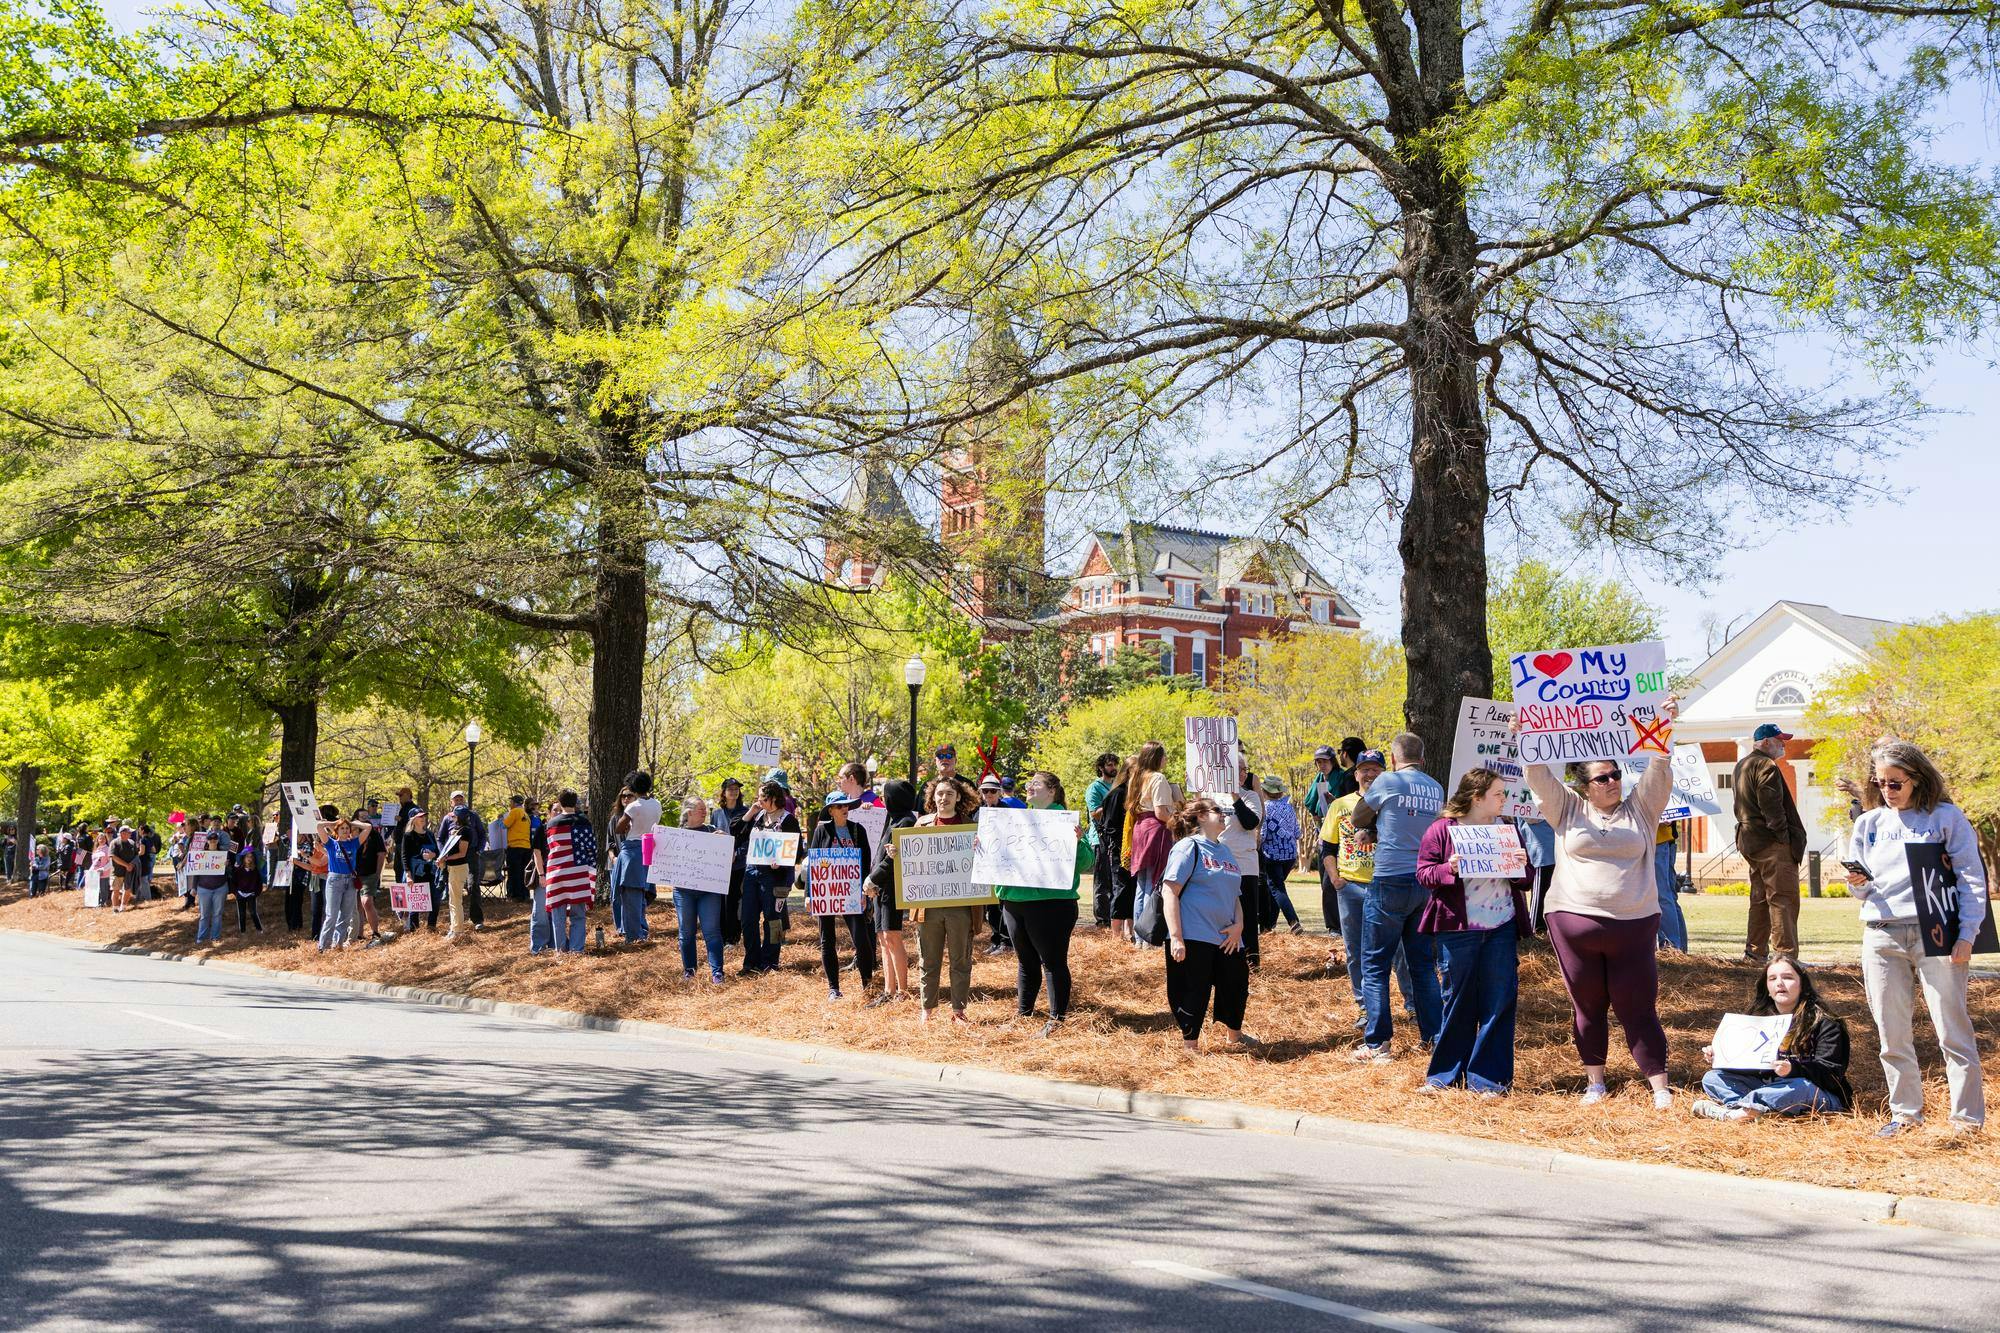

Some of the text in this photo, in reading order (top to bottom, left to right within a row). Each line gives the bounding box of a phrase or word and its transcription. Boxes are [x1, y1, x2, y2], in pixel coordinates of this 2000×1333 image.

[1512, 651, 1627, 688] I My
[1538, 671, 1665, 705] Country BUT
[1758, 671, 1797, 703] LANGDON
[1468, 705, 1511, 722] I PLEDG
[1520, 703, 1656, 730] ASHAMED of my
[1186, 717, 1237, 745] UPHOLD
[1473, 728, 1486, 738] TO
[1490, 730, 1507, 739] THE
[745, 735, 779, 756] VOTE
[1196, 743, 1233, 768] YOUR
[1477, 743, 1502, 755] ONE
[1520, 729, 1632, 763] GOVERNMENT
[1195, 766, 1235, 793] OATH
[1409, 783, 1440, 799] UNPAID
[1671, 788, 1714, 805] Mind
[1513, 805, 1532, 816] FOR
[753, 838, 797, 858] NOPE
[901, 838, 924, 858] NO
[927, 833, 972, 856] HUMAN
[1006, 834, 1072, 858] PERSON
[811, 864, 860, 882] NO KINGS
[408, 893, 430, 901] FREEDOM
[411, 885, 425, 894] LET
[812, 882, 851, 897] NO WAR
[906, 881, 960, 902] STOLEN
[1921, 867, 1959, 926] Kin
[411, 902, 427, 910] RING
[812, 898, 846, 913] NO ICE
